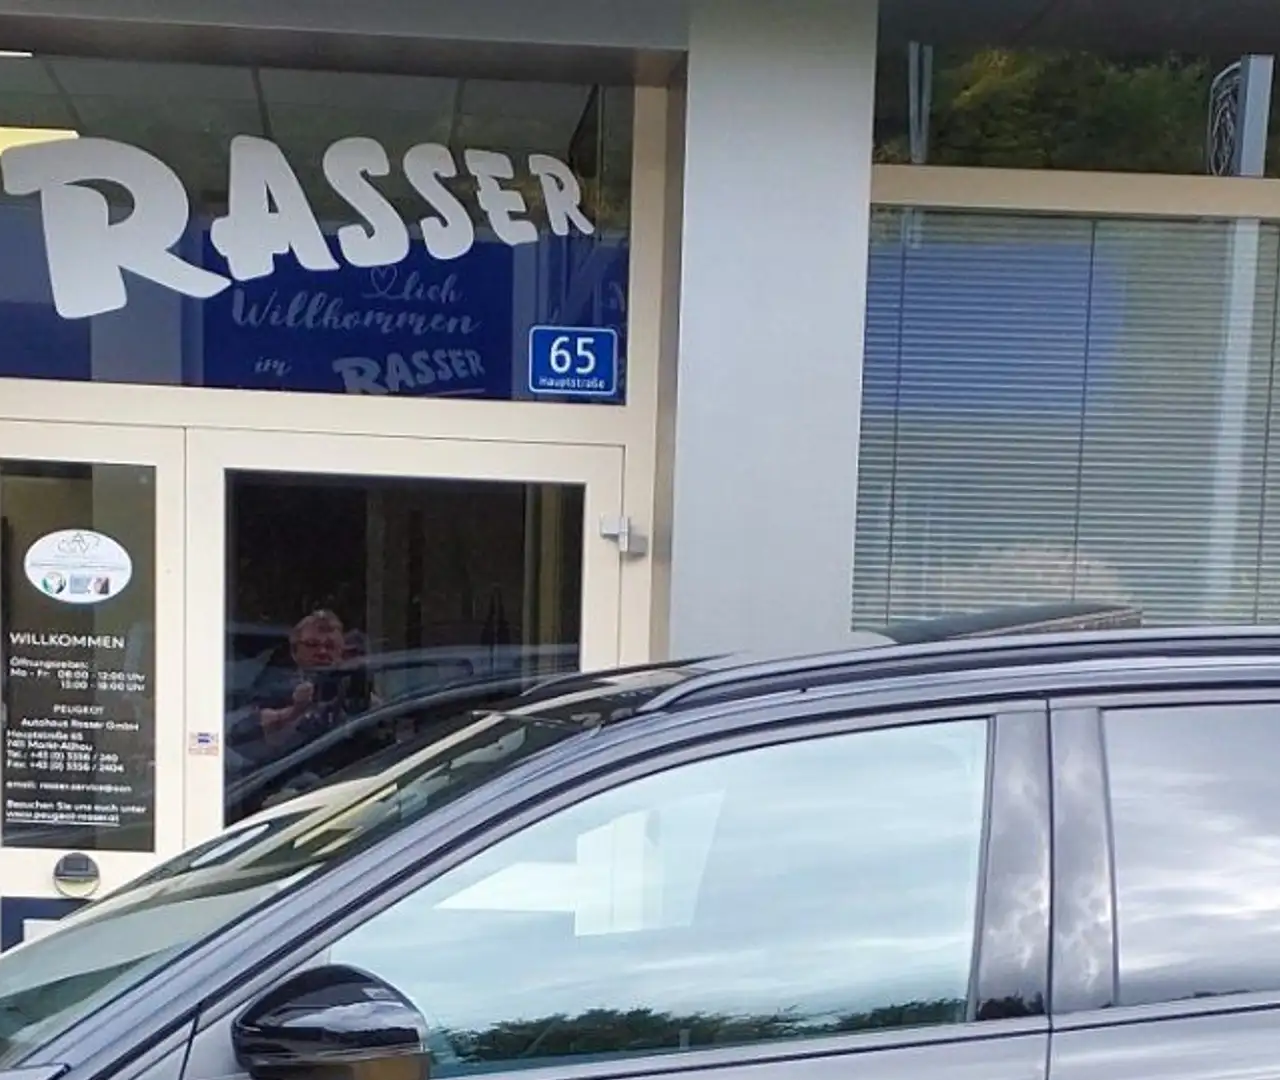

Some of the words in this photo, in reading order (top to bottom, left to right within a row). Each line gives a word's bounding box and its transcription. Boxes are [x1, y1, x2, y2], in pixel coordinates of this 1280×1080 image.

[0, 134, 595, 320] RASSER
[232, 288, 483, 336] Willkommen
[550, 335, 596, 375] 65
[332, 349, 486, 395] RASSER
[538, 375, 606, 389] Hauptstraße
[9, 631, 125, 649] WILLKOMMEN
[53, 704, 105, 715] PEUGEOT
[21, 717, 69, 729] Autohaus
[106, 720, 139, 731] GmbH
[6, 799, 54, 810] Besuchen
[56, 801, 72, 811] Sie
[120, 804, 148, 813] unter
